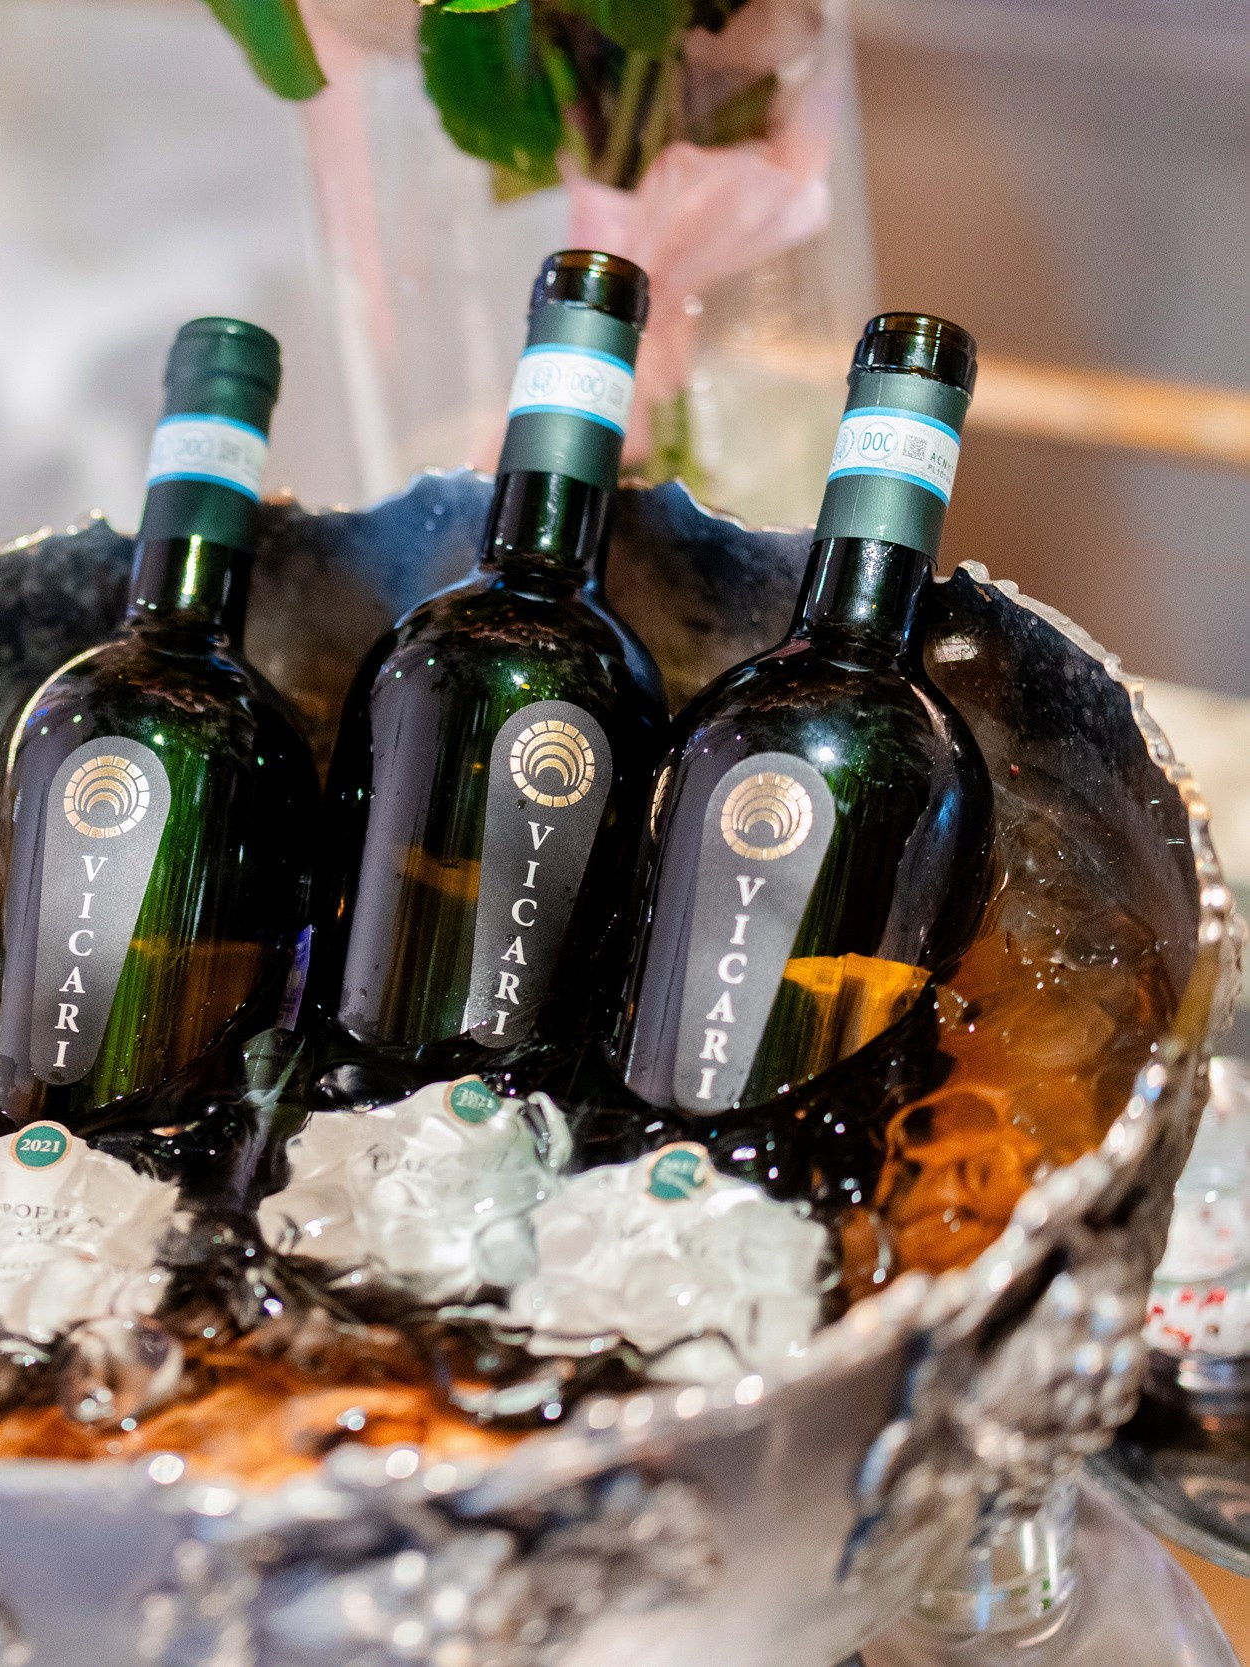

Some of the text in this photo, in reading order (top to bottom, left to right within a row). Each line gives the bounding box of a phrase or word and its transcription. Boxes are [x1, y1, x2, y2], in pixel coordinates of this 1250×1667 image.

[570, 371, 606, 397] DOC
[861, 431, 894, 453] DOC
[52, 855, 109, 1068] VICARI
[491, 821, 555, 1036] VICARI
[696, 874, 767, 1100] VICARI
[19, 1138, 61, 1153] 2021
